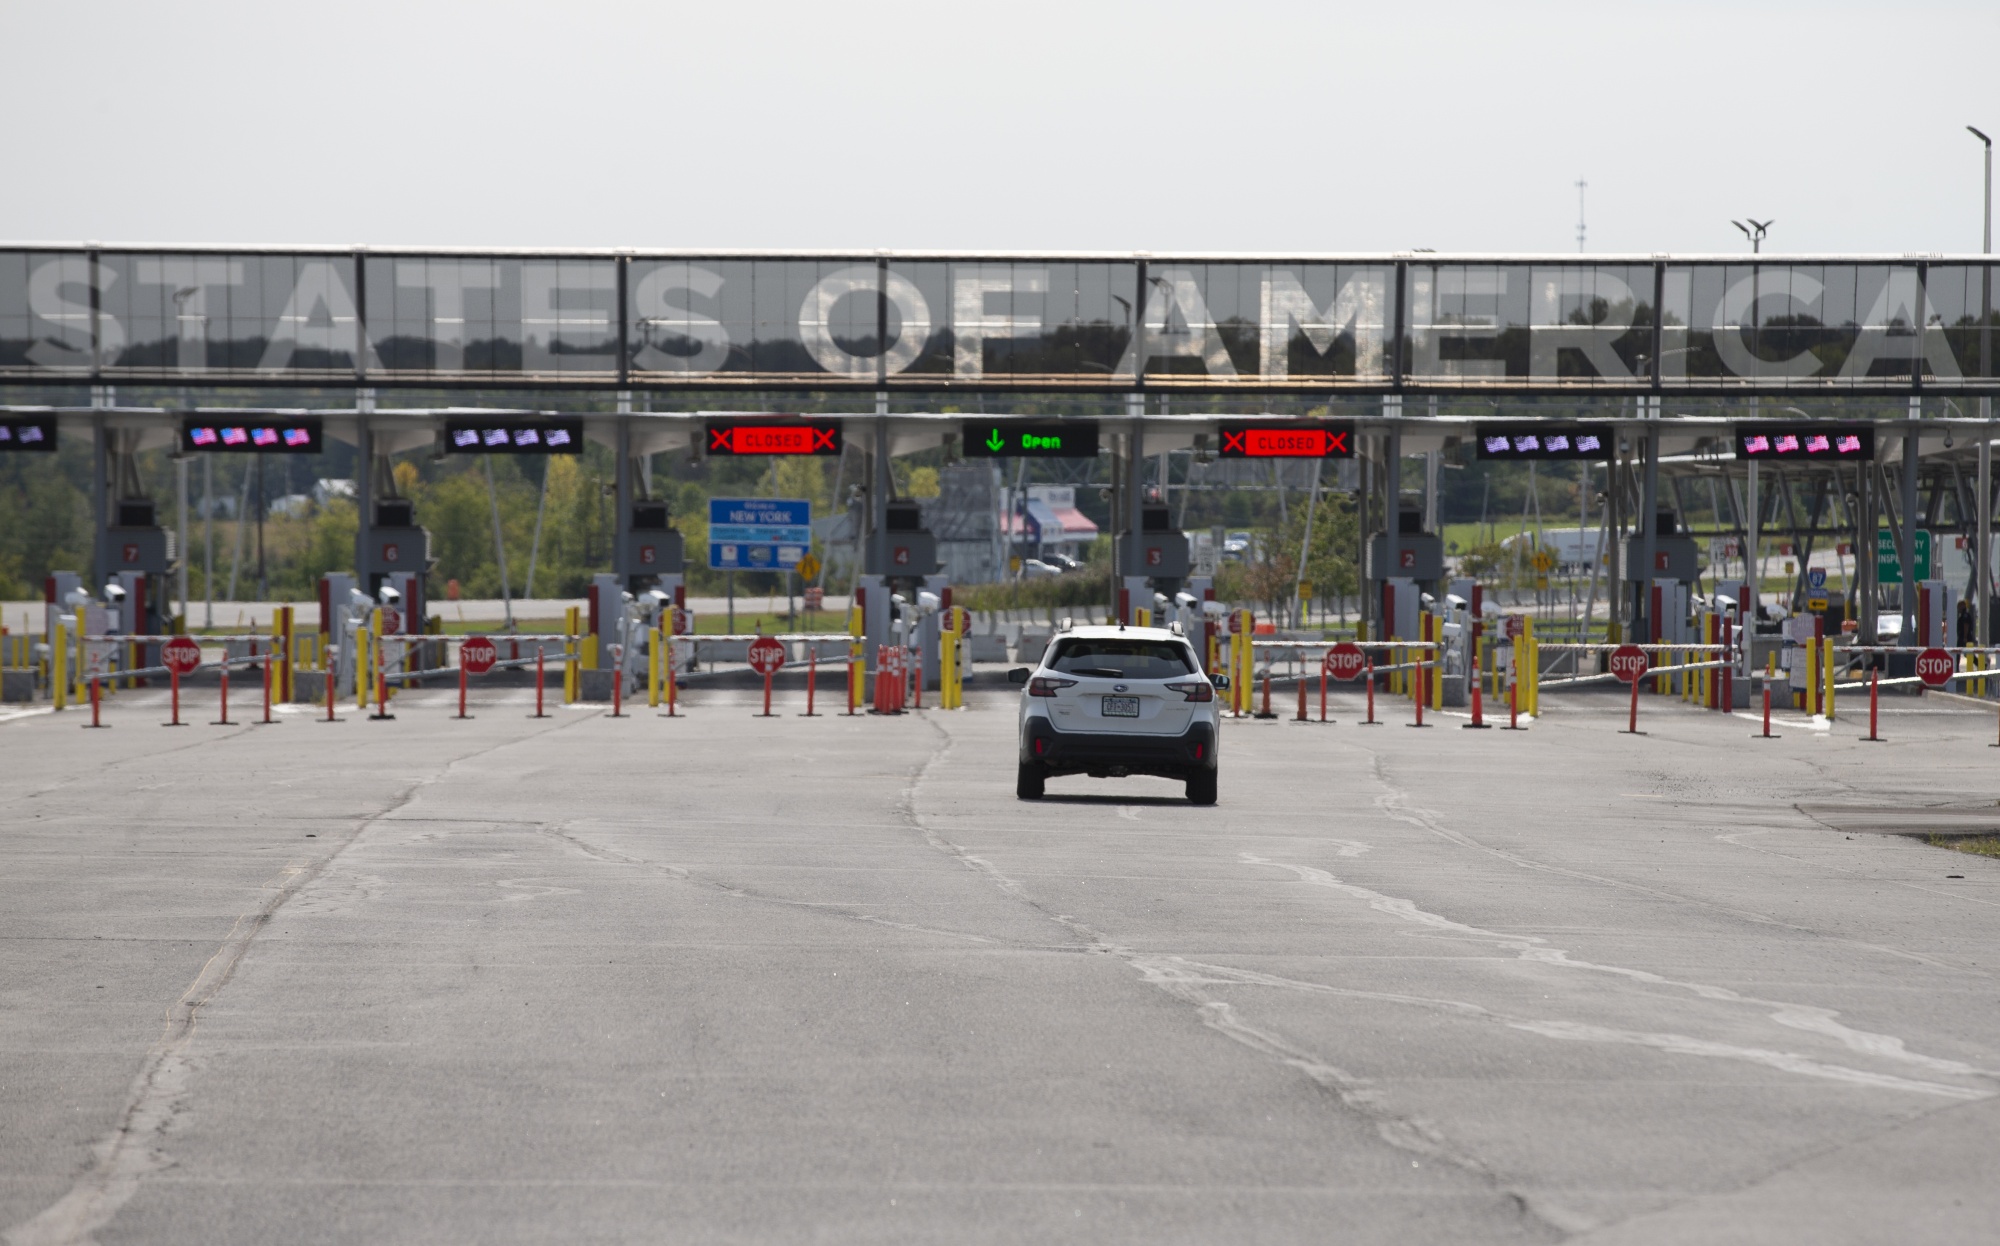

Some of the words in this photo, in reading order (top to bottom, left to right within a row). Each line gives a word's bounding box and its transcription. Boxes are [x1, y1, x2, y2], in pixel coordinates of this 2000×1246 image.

[24, 258, 729, 373] STATES
[798, 266, 1049, 379] OF
[1111, 269, 1966, 383] AMERICA
[745, 434, 802, 447] CLOSED
[1022, 434, 1061, 449] Open
[1258, 437, 1314, 450] CLOSED
[729, 510, 757, 522] NEW
[758, 511, 791, 523] YORK
[1878, 539, 1924, 550] SECRY
[126, 547, 137, 561] 7
[387, 547, 398, 560] 6
[644, 549, 655, 563] 5
[897, 551, 908, 563] 4
[1151, 551, 1161, 564] 3
[1404, 554, 1415, 567] 2
[1812, 573, 1823, 584] 87
[165, 647, 199, 663] STOP
[1328, 653, 1362, 669] STOP
[1613, 656, 1645, 671] STOP
[1919, 658, 1952, 673] STOP
